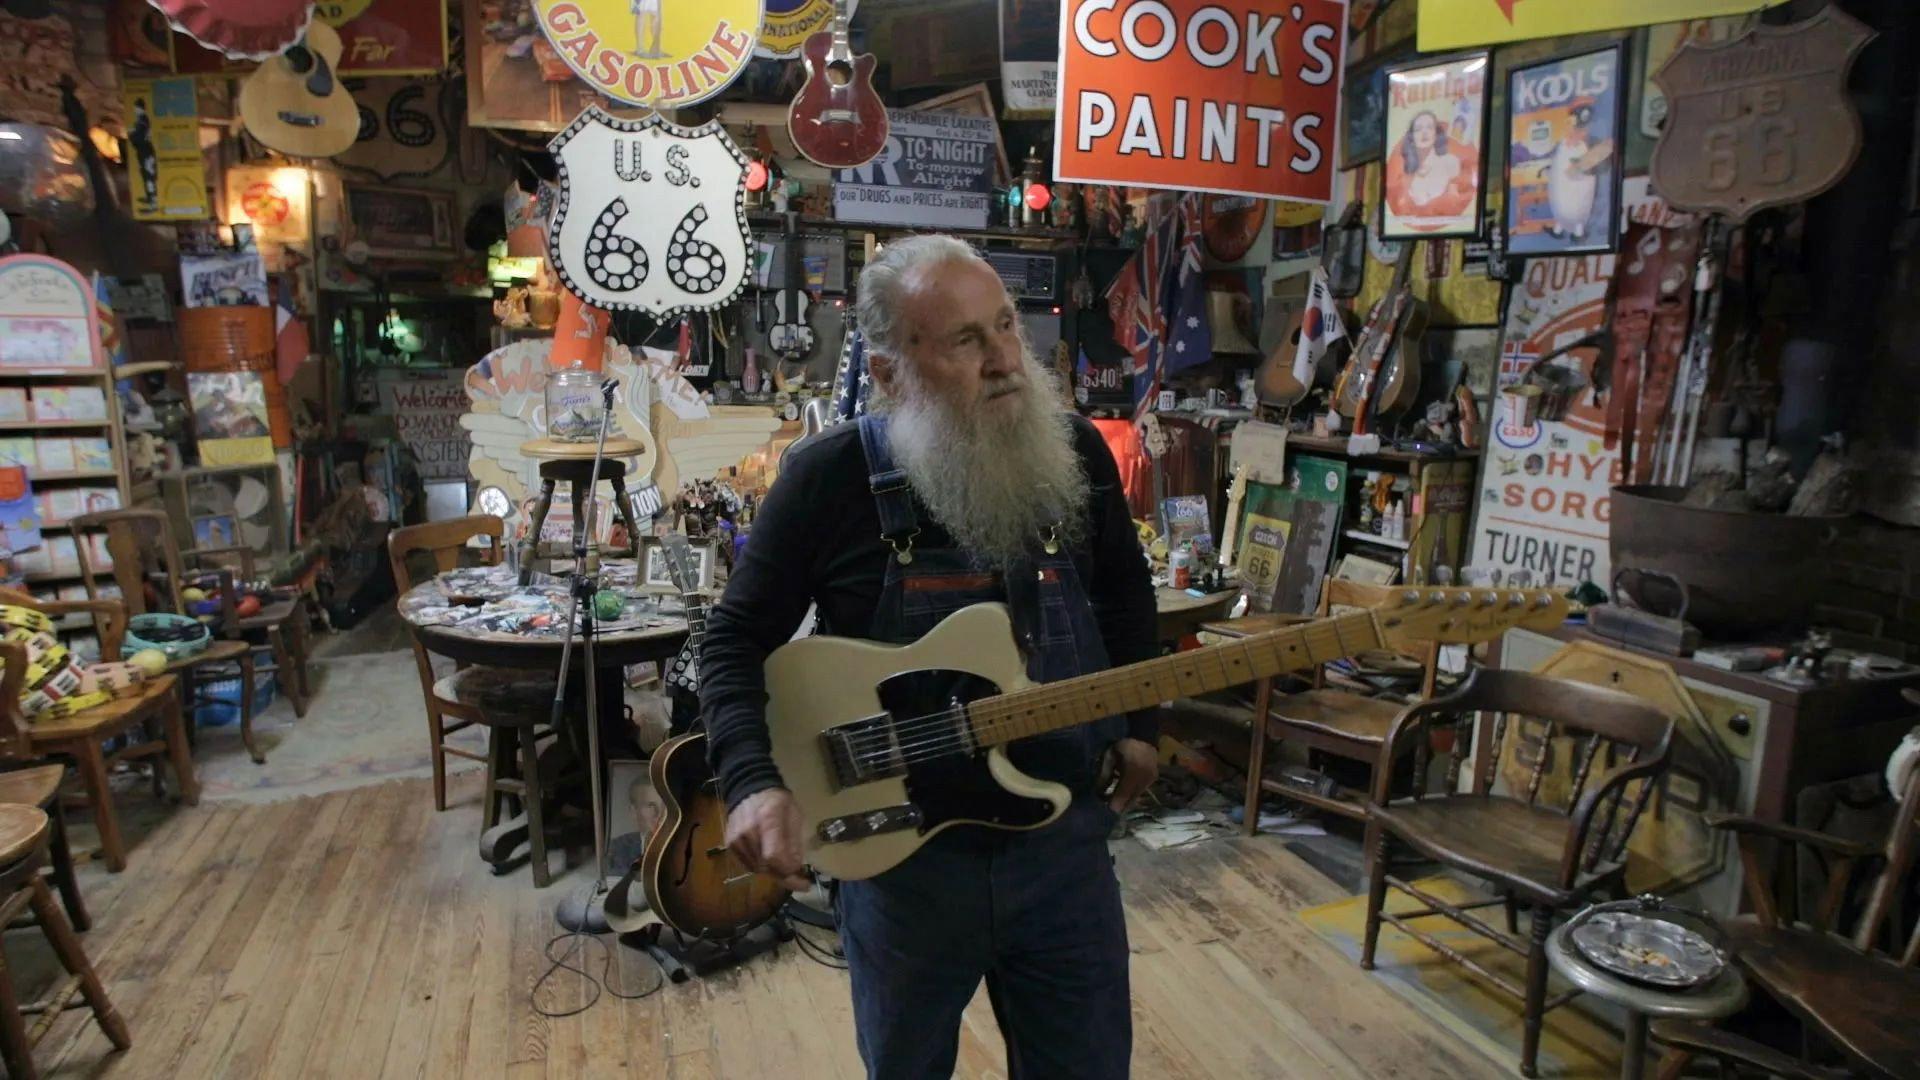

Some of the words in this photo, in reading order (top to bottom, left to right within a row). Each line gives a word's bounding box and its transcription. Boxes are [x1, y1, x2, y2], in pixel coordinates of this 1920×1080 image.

[351, 37, 396, 62] Far
[547, 3, 749, 100] GASOLINE
[1073, 0, 1335, 86] COOK'S
[1518, 64, 1609, 109] KOOLS
[1076, 88, 1322, 174] PAINTS
[906, 158, 985, 176] To-morrow
[912, 172, 974, 191] Alright
[860, 188, 891, 204] DRUGS
[894, 196, 912, 205] AND
[584, 196, 727, 295] 66
[1249, 556, 1271, 579] 66
[1485, 528, 1596, 584] TURNER
